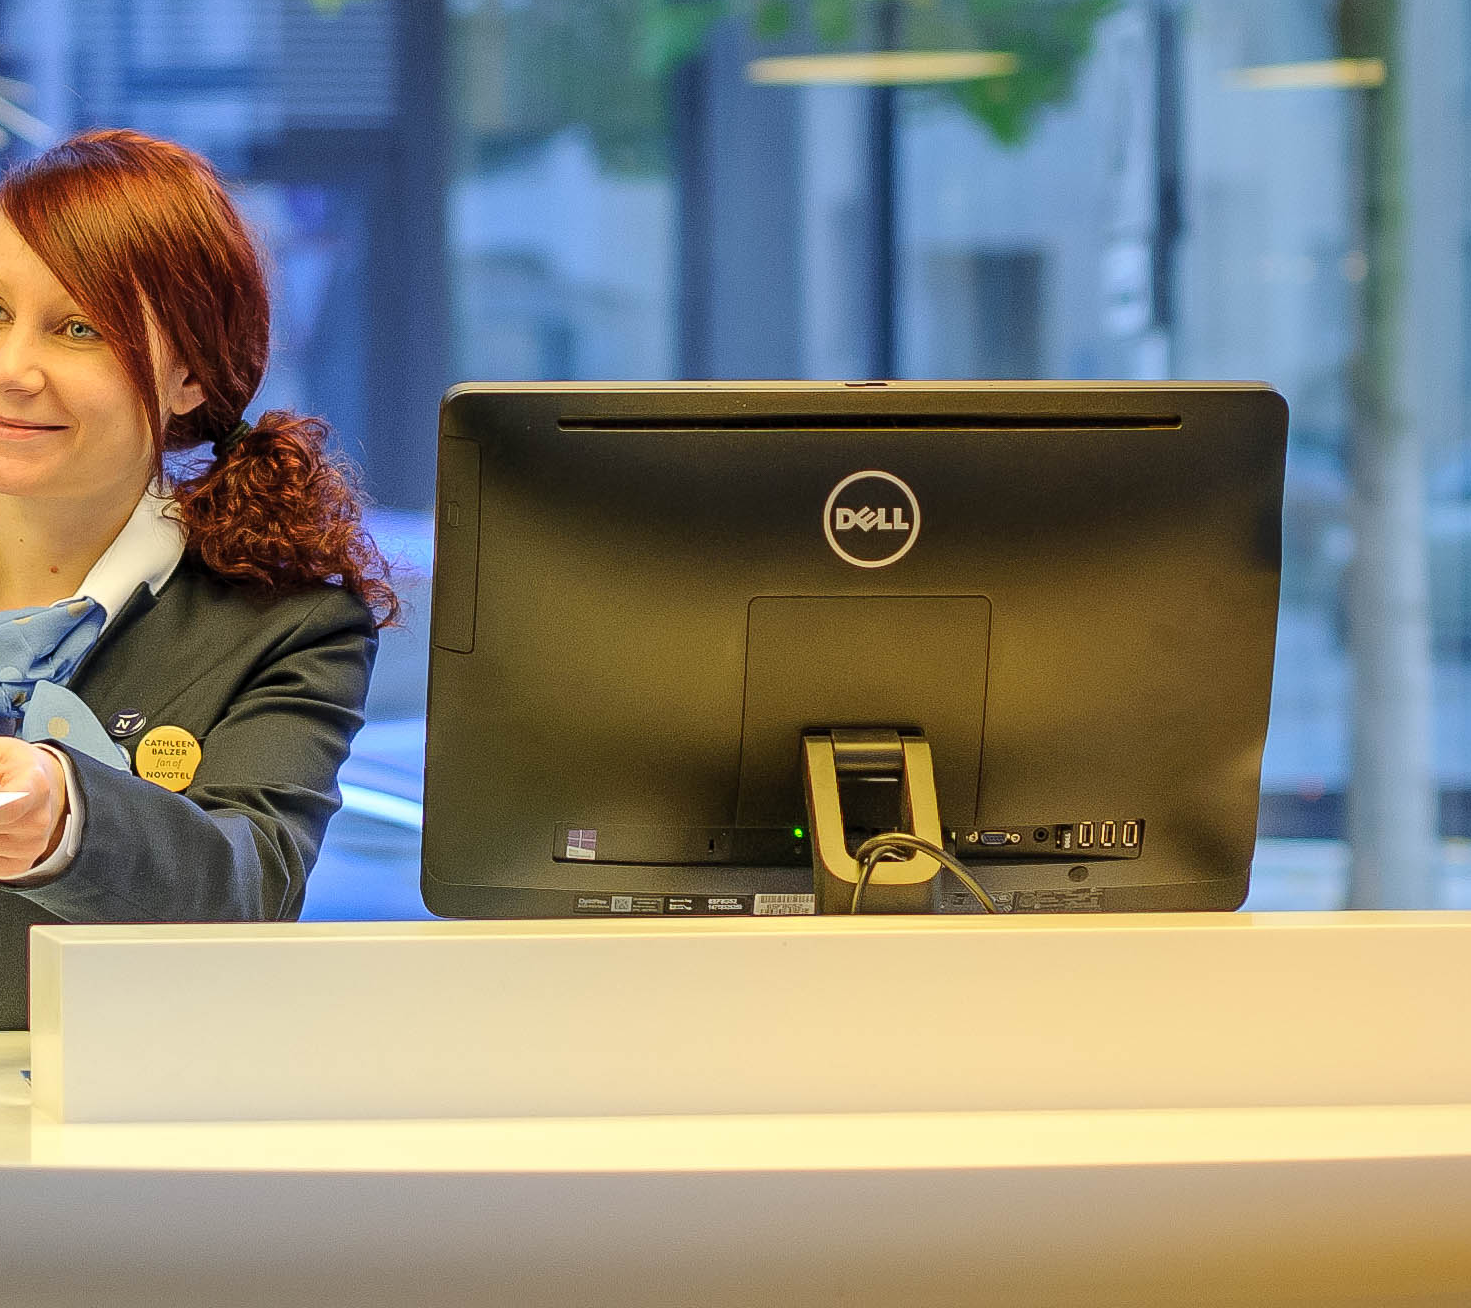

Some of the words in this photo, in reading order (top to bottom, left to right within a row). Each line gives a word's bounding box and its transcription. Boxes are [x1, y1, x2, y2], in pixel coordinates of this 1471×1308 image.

[836, 506, 909, 532] DELL
[115, 718, 131, 730] N
[144, 739, 195, 748] CATHLEEN
[151, 748, 188, 756] BALZER
[156, 757, 171, 768] fan
[173, 757, 184, 770] of
[145, 771, 192, 780] NOVOTEL
